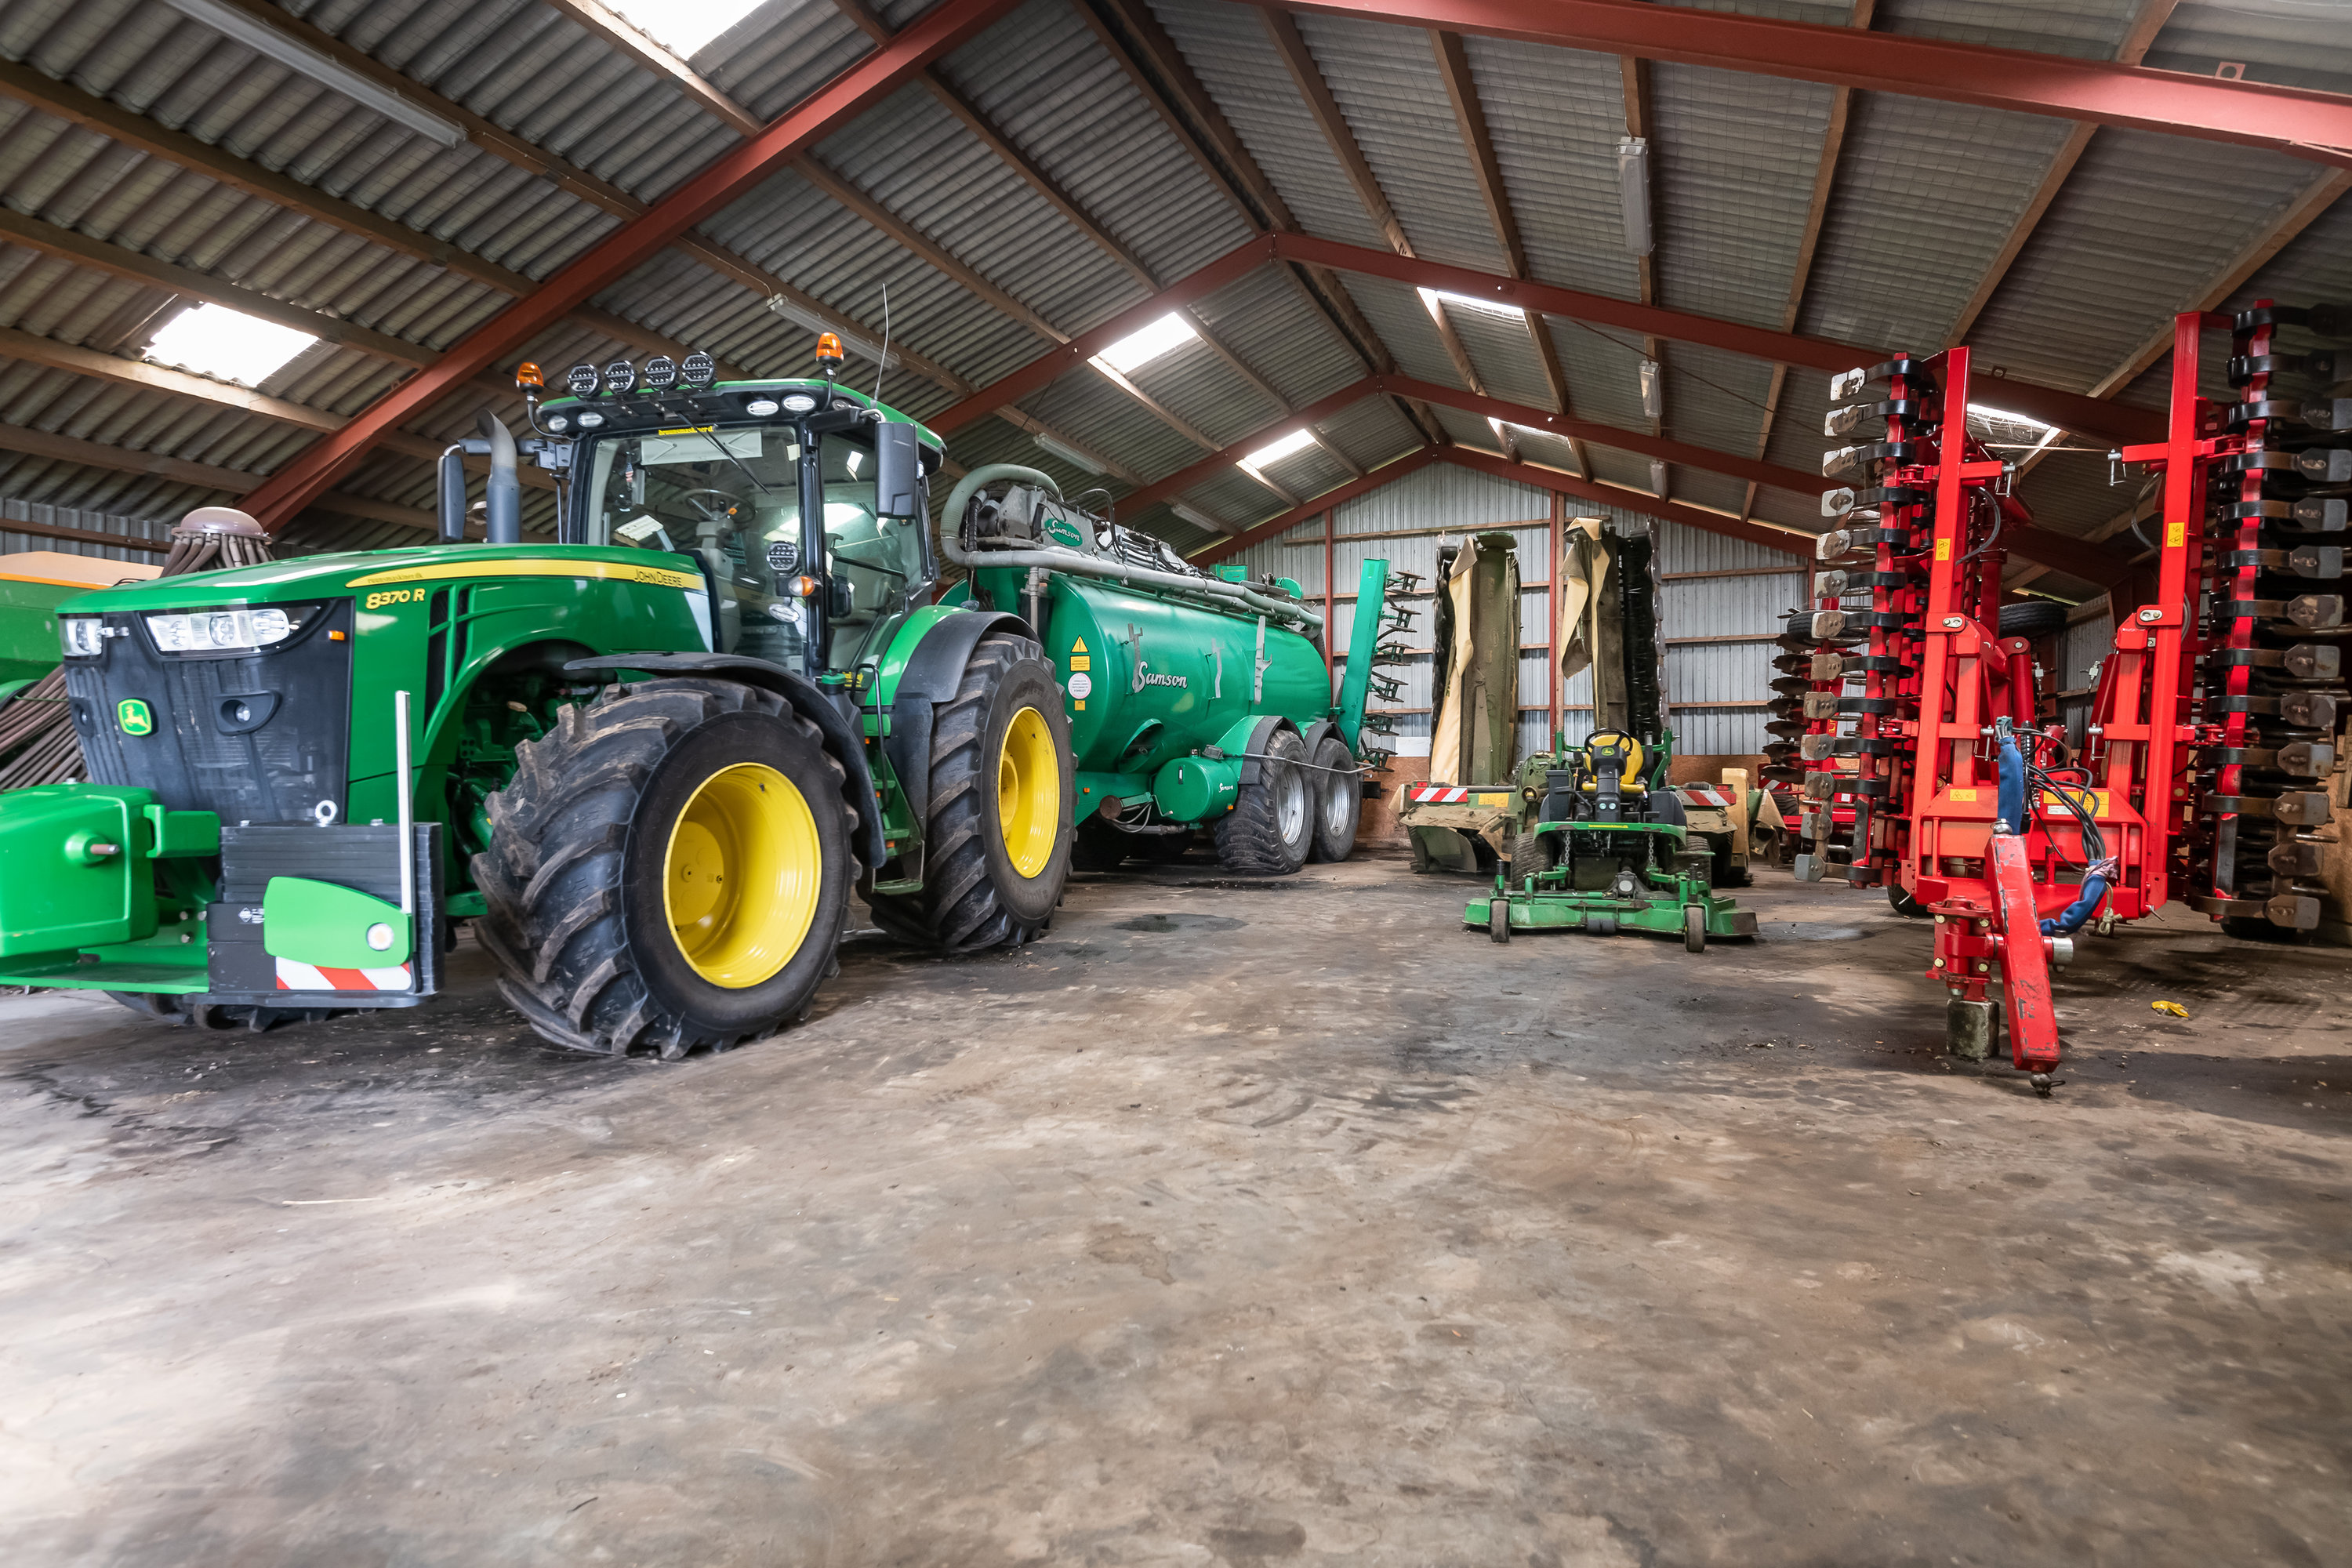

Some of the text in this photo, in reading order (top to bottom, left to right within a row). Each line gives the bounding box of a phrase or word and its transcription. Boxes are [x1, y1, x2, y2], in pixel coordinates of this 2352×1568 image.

[1047, 520, 1080, 541] Samson
[633, 568, 683, 586] JOHN DEERE
[365, 588, 426, 609] 8370 R
[1132, 661, 1188, 693] Samson
